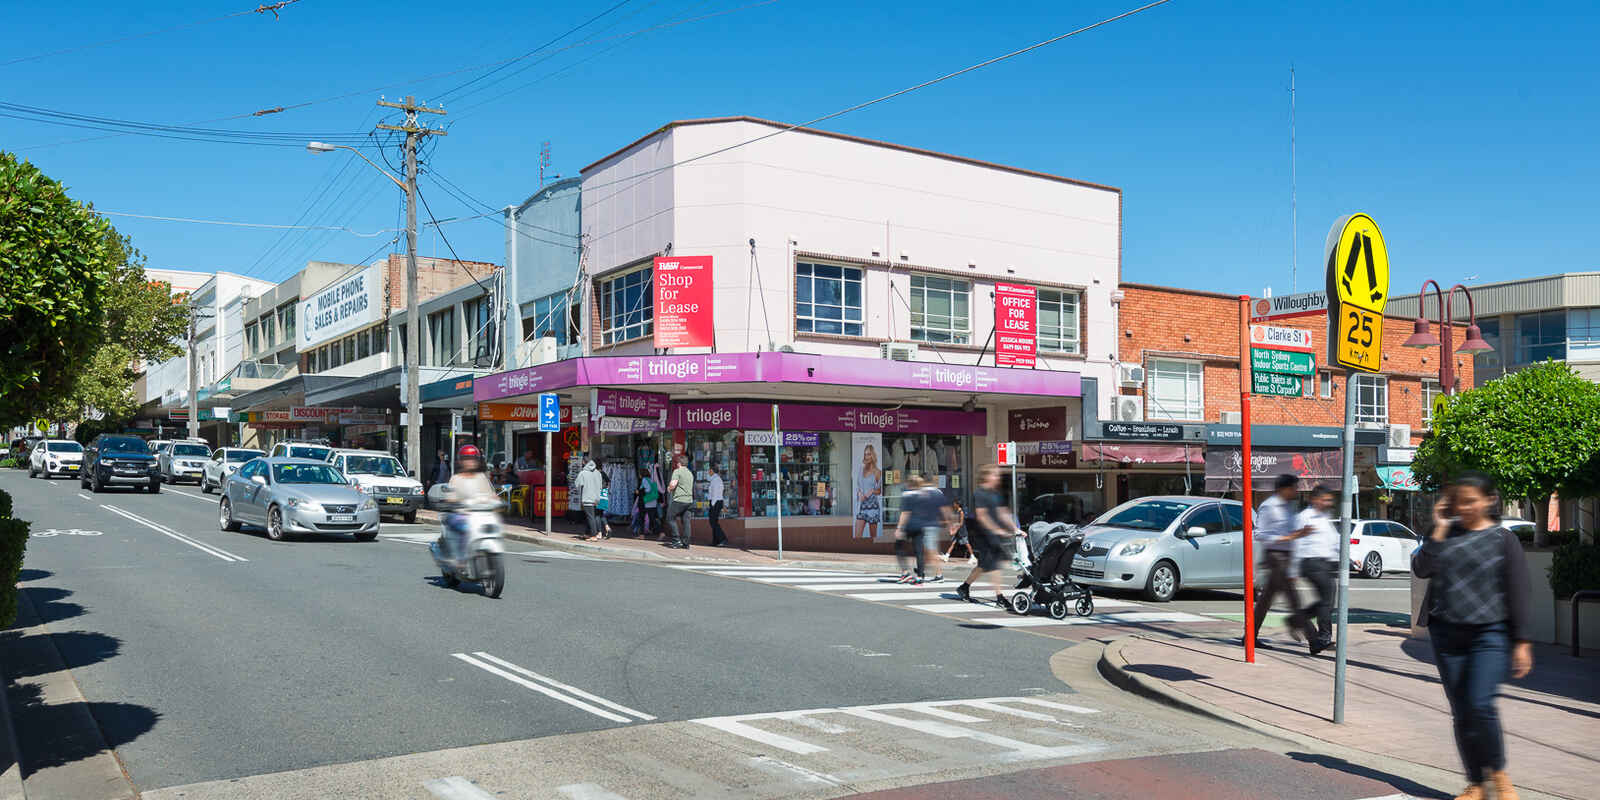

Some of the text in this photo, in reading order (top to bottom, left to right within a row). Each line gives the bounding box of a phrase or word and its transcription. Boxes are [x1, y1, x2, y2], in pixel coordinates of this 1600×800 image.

[659, 273, 693, 288] Shop
[317, 275, 364, 312] MOBILE PHONE
[660, 287, 679, 300] for
[660, 301, 699, 314] Lease
[1002, 297, 1030, 308] OFFICE
[1273, 294, 1325, 310] Willoughby
[314, 293, 369, 331] SALES & REPAIRS
[1008, 308, 1025, 319] FOR
[1004, 319, 1030, 331] LEASE
[1347, 311, 1373, 348] 25
[1267, 327, 1302, 342] Clarke St
[1254, 349, 1290, 363] North Sydney
[648, 359, 699, 378] trilogie
[1254, 358, 1271, 369] Indoor
[1271, 360, 1289, 371] Sports
[935, 368, 972, 386] trilogie
[1254, 372, 1270, 383] Public
[1270, 373, 1286, 385] Toilets
[546, 397, 554, 408] P
[620, 394, 646, 412] trilogie
[686, 407, 732, 425] trilogie
[860, 411, 894, 428] trilogie
[1108, 424, 1127, 433] Coffee
[1162, 425, 1179, 434] Lunch
